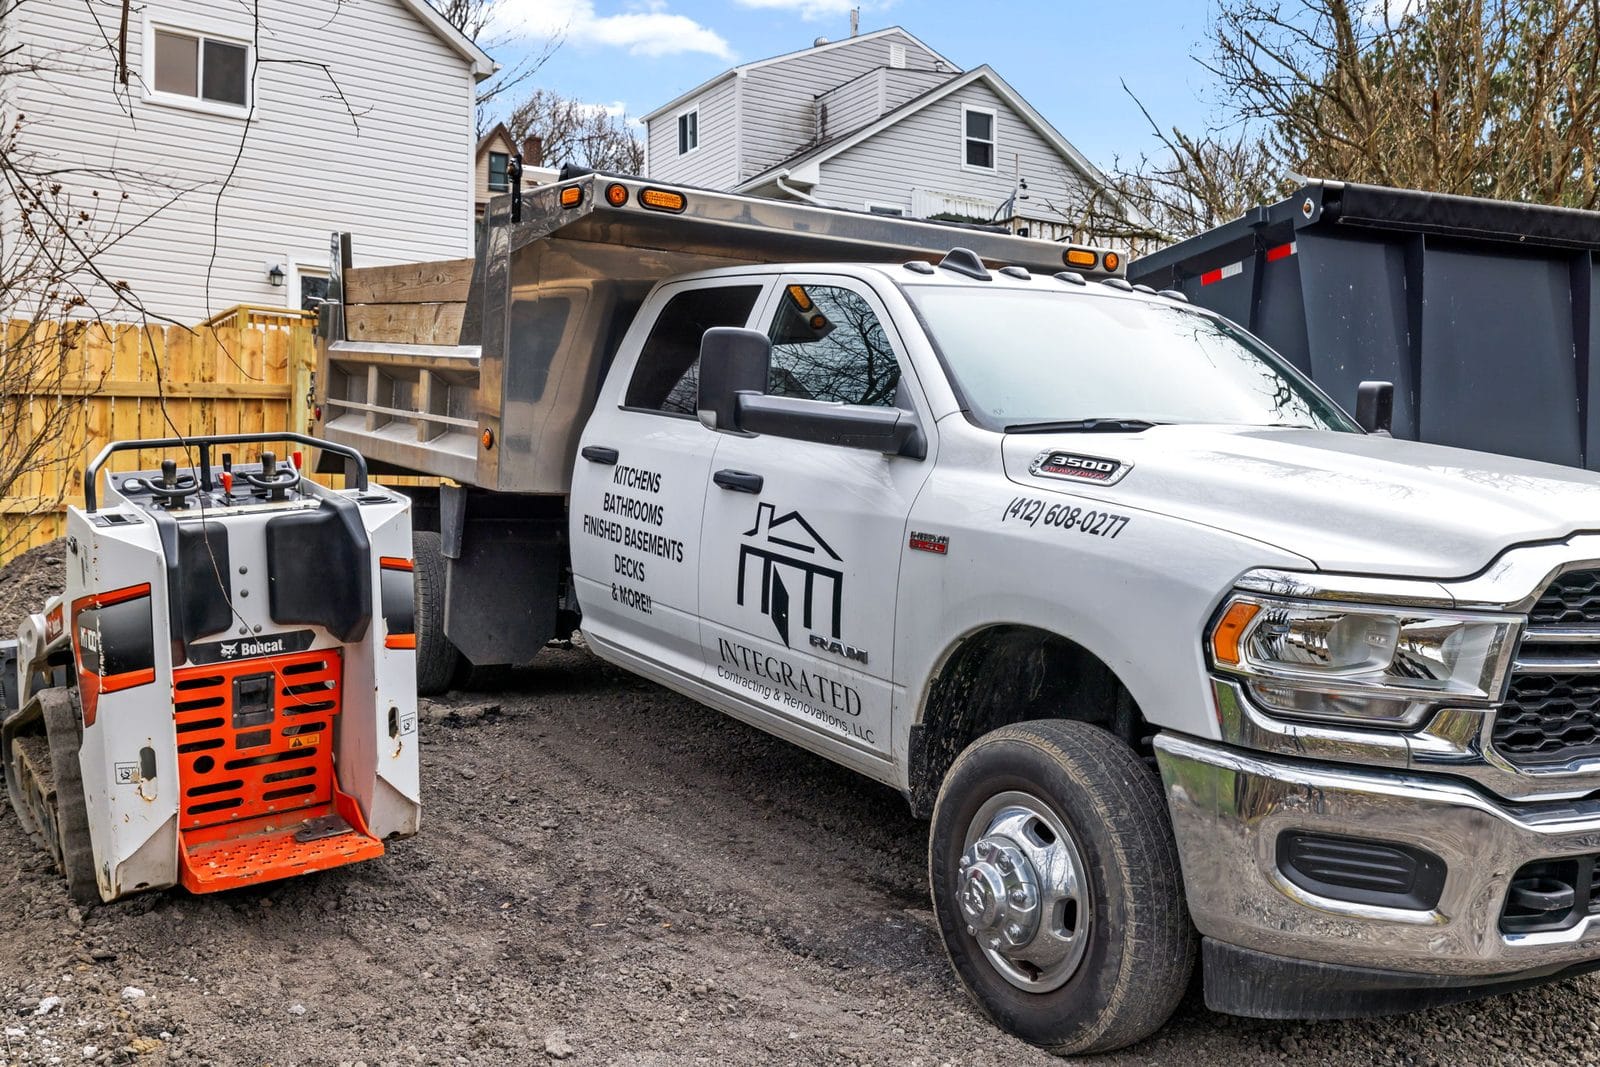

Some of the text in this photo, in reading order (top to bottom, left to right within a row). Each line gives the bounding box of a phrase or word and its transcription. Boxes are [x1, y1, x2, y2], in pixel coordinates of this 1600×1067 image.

[613, 465, 662, 493] KITCHENS
[1052, 455, 1113, 472] 3500
[603, 492, 664, 527] BATHROOMS
[1001, 497, 1131, 539] (412) 608-0277
[583, 514, 684, 563] FINISHED BASEMENTS
[614, 553, 645, 582] DECKS
[611, 583, 653, 615] & MORE!!
[241, 639, 283, 656] Bobcat
[809, 634, 869, 665] RAM
[718, 637, 862, 717] INTEGRATED
[717, 665, 875, 744] Contracting & Renovations, LLC
